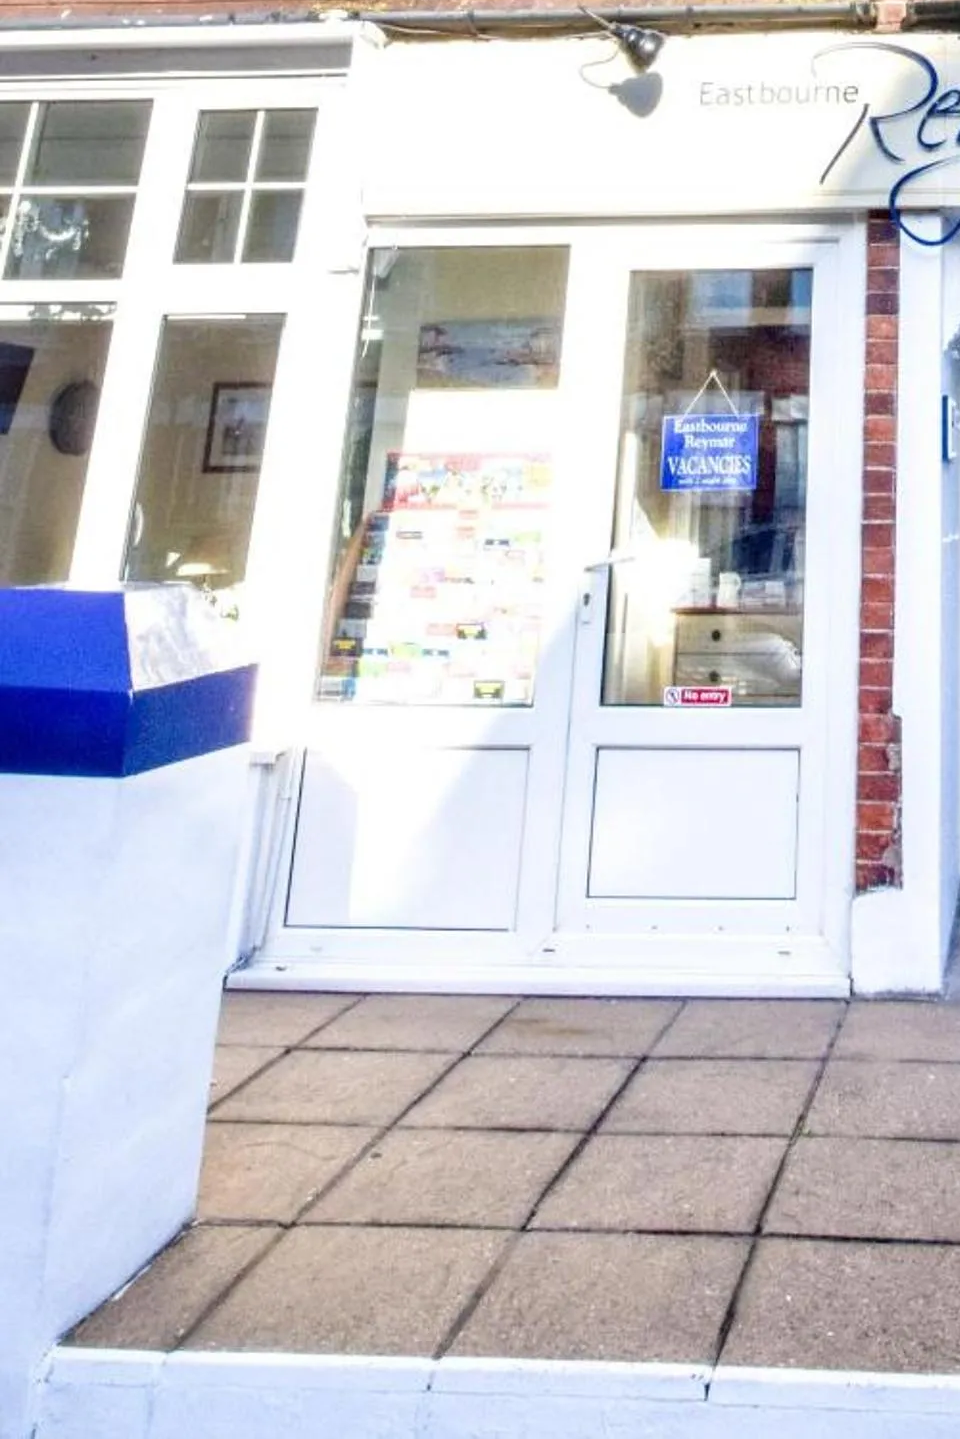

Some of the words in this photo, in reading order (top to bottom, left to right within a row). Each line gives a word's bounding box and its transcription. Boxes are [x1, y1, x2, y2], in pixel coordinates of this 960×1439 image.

[700, 82, 860, 105] Eastbourne
[674, 418, 748, 433] Eastbourne
[684, 434, 736, 450] Reymar
[667, 454, 751, 475] VACANCIES
[684, 690, 699, 700] No
[700, 691, 727, 704] entry
